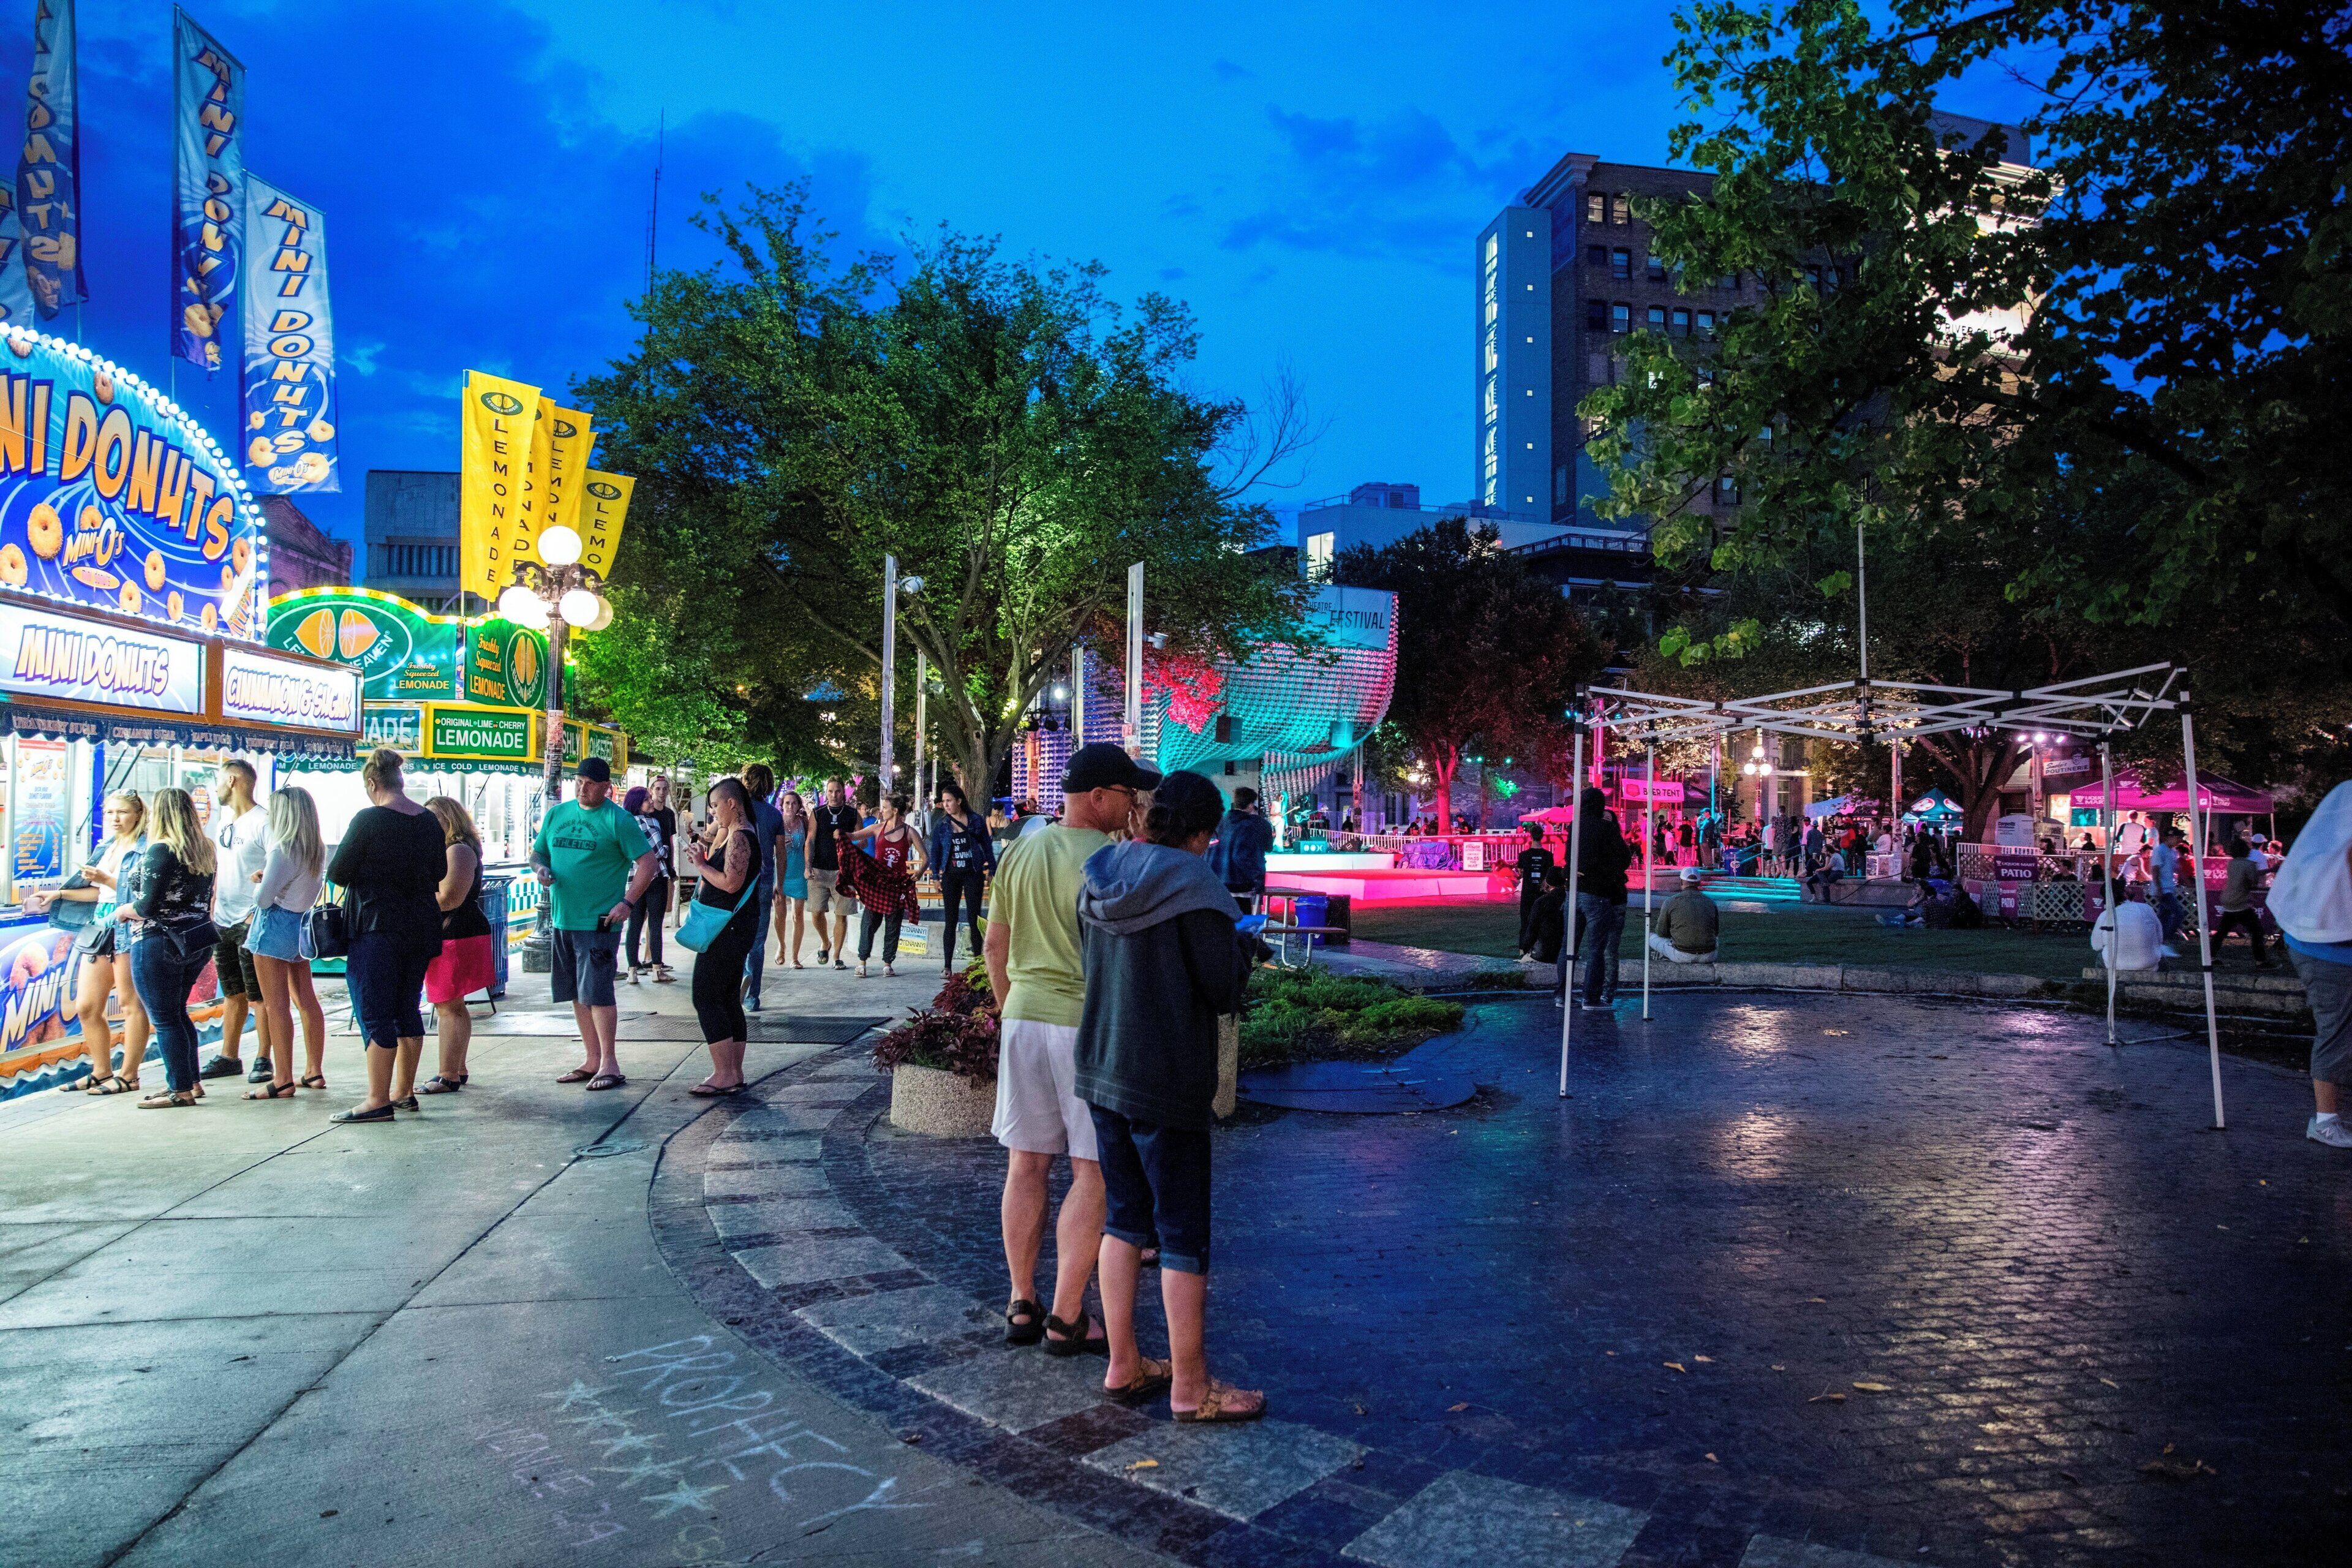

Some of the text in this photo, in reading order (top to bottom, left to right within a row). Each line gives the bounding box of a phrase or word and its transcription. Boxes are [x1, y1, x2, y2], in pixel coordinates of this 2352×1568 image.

[191, 45, 236, 159] MINI
[260, 197, 315, 457] MINI DONUTS
[1945, 323, 1973, 334] RIVER
[486, 397, 519, 413] LEMON HEAVEN
[59, 390, 236, 564] DONUTS
[487, 418, 508, 583] LEMONADE
[1330, 610, 1385, 629] FESTIVAL
[349, 634, 394, 669] EAVEN
[477, 632, 500, 660] Freshly
[13, 624, 169, 696] MINI DONUTS
[475, 650, 502, 673] Squeezed
[404, 669, 440, 679] Squeezed
[225, 665, 353, 722] CINNAMON & SUGAR
[394, 680, 450, 690] LEMONADE
[469, 674, 506, 701] LEMONADE
[440, 717, 526, 729] ORIGINAL LIME CHERRY
[435, 729, 524, 749] LEMONADE
[562, 730, 580, 758] SHLY
[478, 763, 519, 772] LEMONADE
[2045, 765, 2089, 774] POUTINERIE
[1643, 787, 1680, 797] BER TENT
[555, 819, 598, 838] UNDER ARMOUR
[552, 837, 596, 850] ATHLETICS
[2000, 869, 2032, 878] PATIO
[2001, 897, 2015, 908] PATIO
